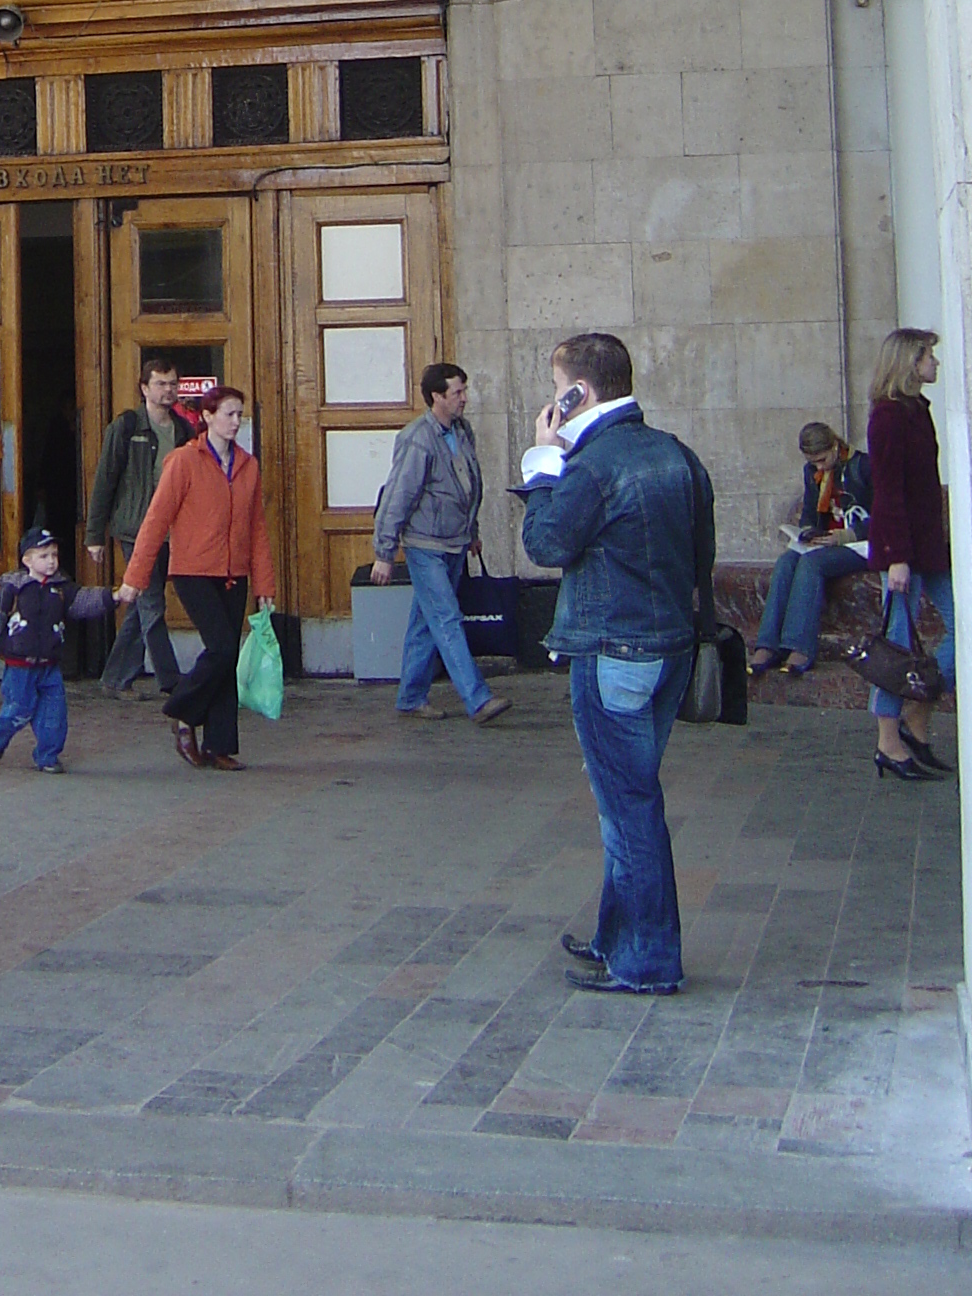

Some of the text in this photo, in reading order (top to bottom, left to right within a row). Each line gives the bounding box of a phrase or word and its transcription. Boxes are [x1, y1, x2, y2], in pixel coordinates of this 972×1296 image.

[96, 164, 150, 186] НЕТ
[178, 382, 200, 392] ХОДА
[463, 614, 504, 622] MPSAX
